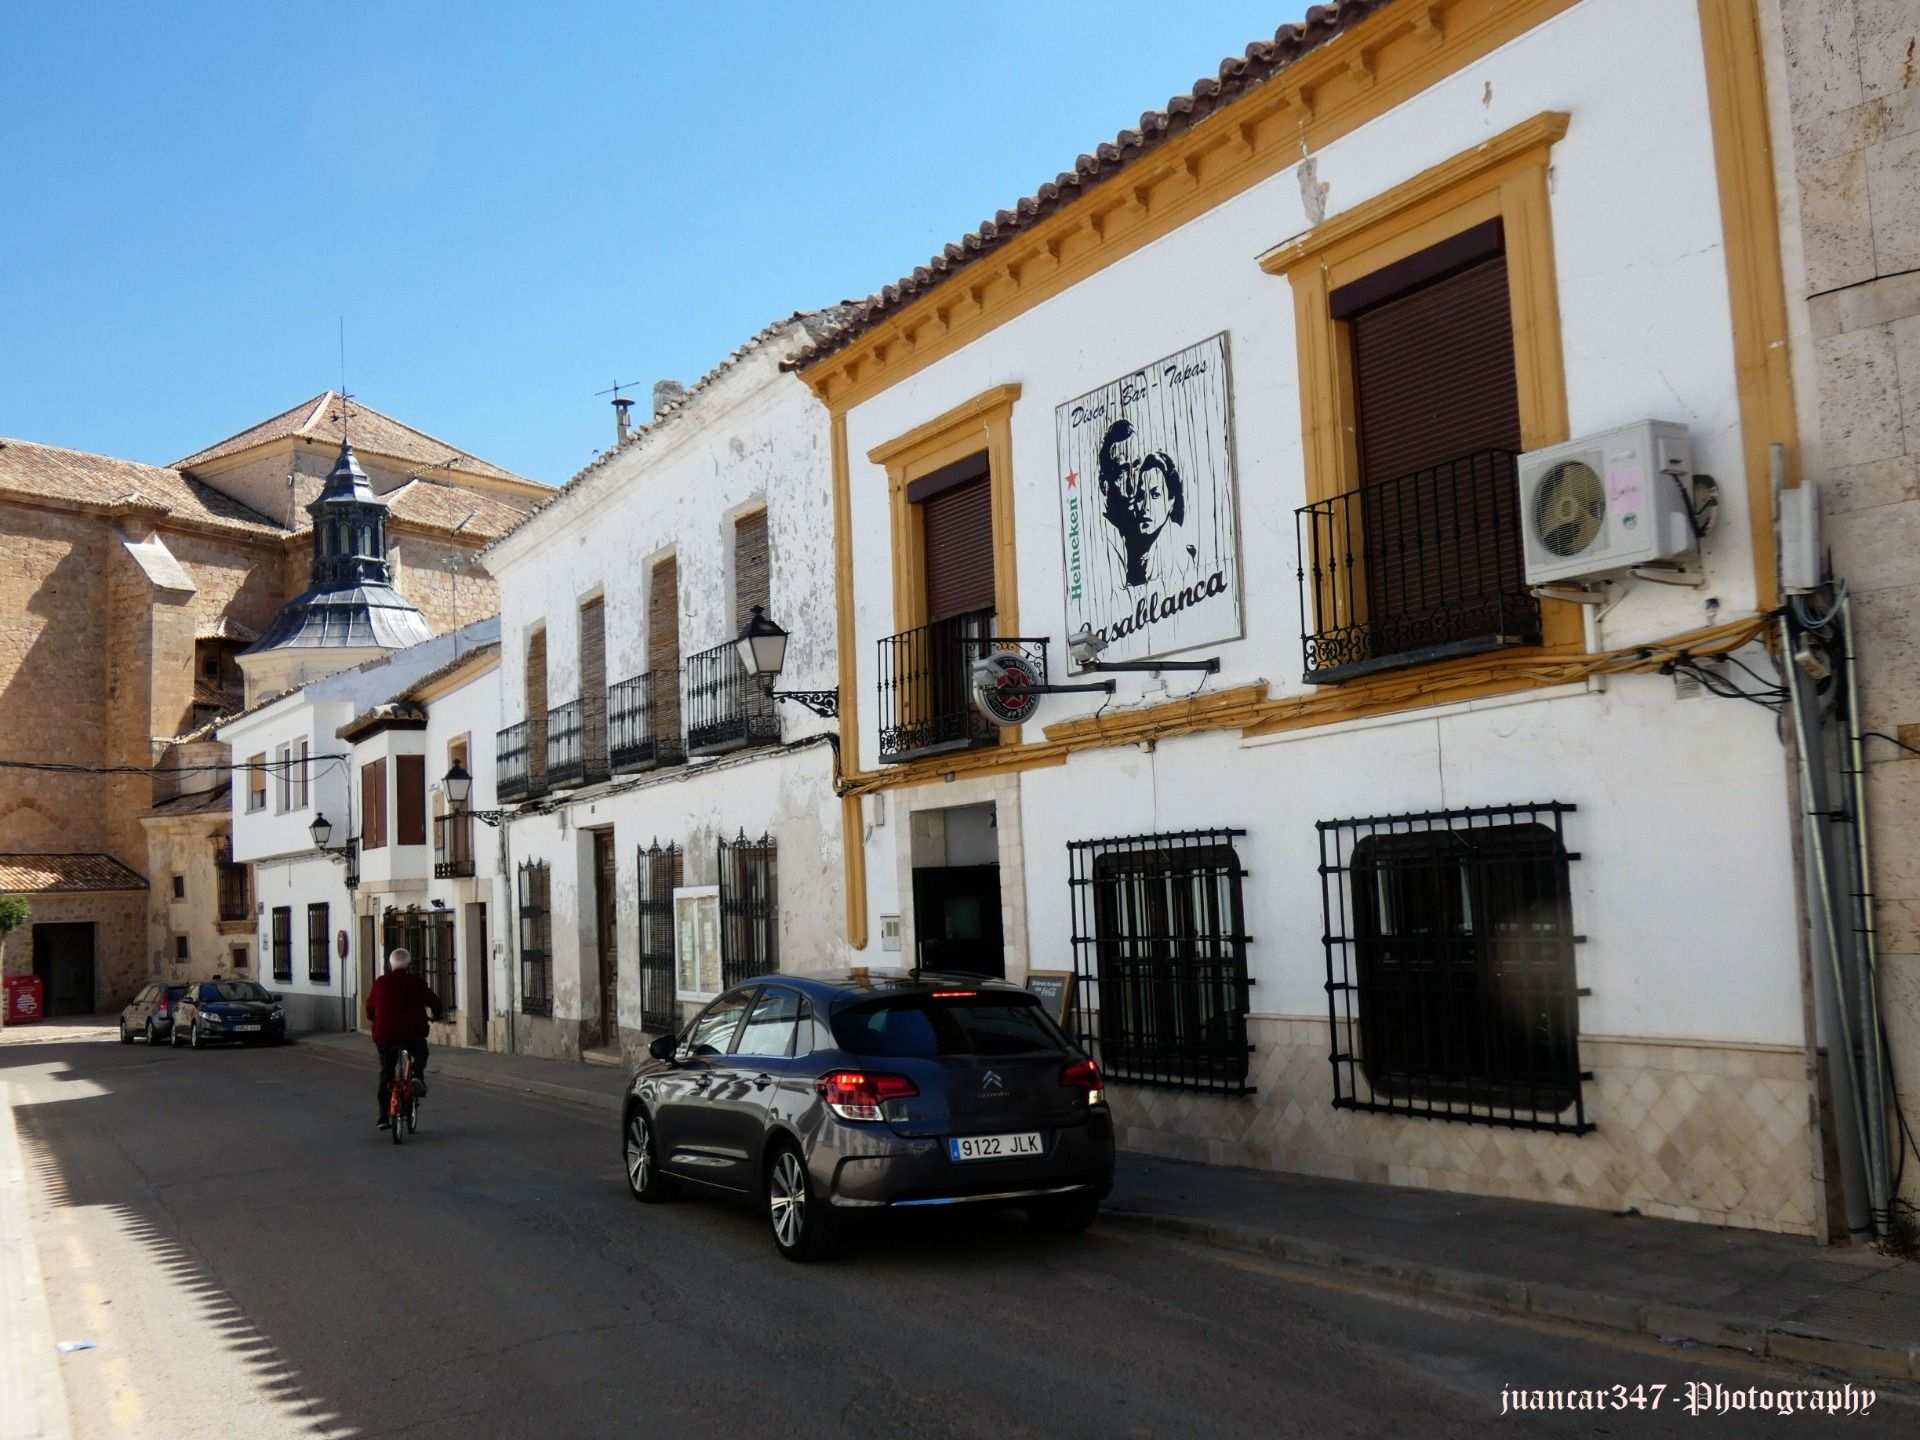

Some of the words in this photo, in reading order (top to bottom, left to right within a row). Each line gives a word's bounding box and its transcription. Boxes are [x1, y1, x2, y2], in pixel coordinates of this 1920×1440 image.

[1071, 405, 1105, 428] Disco
[1122, 384, 1148, 407] Bar
[1164, 360, 1207, 388] Tapas
[1069, 496, 1082, 601] Heineken
[962, 1138, 1002, 1157] 9122
[1010, 1135, 1039, 1153] JLK
